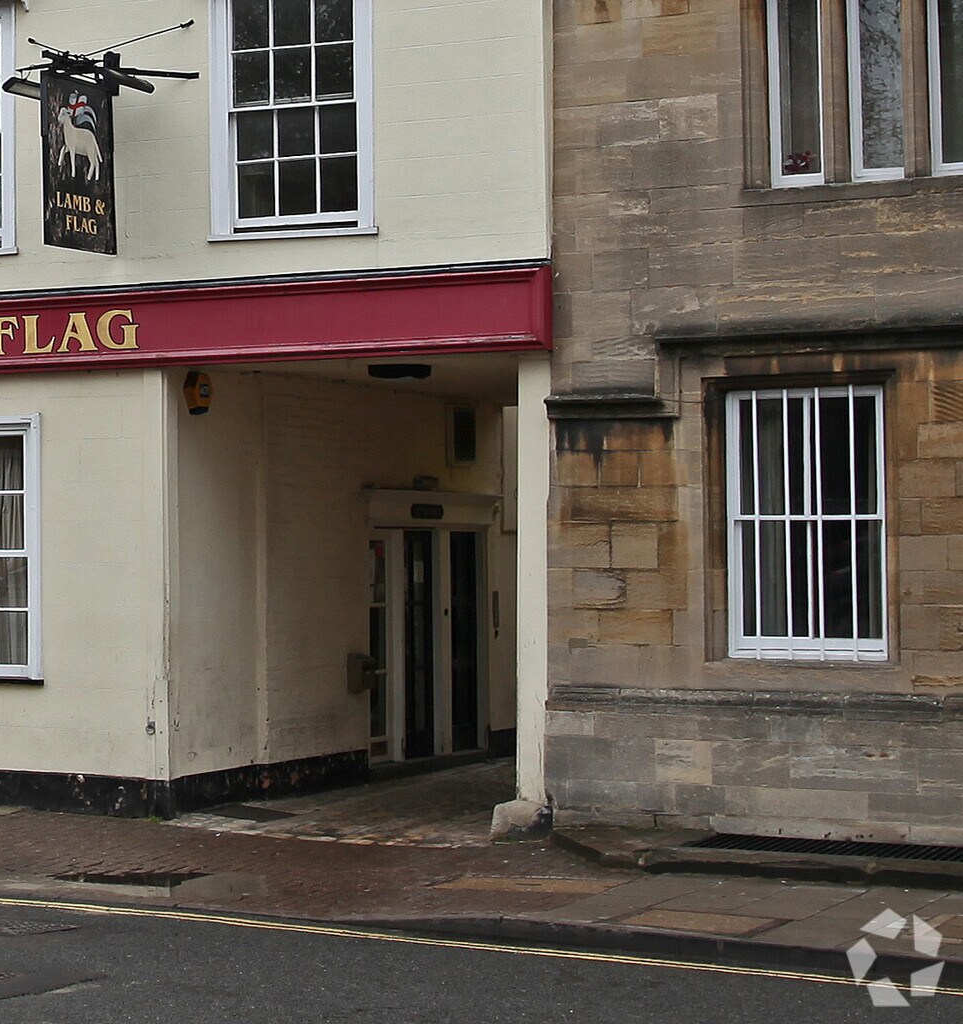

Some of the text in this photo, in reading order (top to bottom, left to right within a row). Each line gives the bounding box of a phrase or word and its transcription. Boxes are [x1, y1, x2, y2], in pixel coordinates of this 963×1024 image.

[56, 191, 106, 215] LAMB &
[65, 215, 98, 235] FLAG
